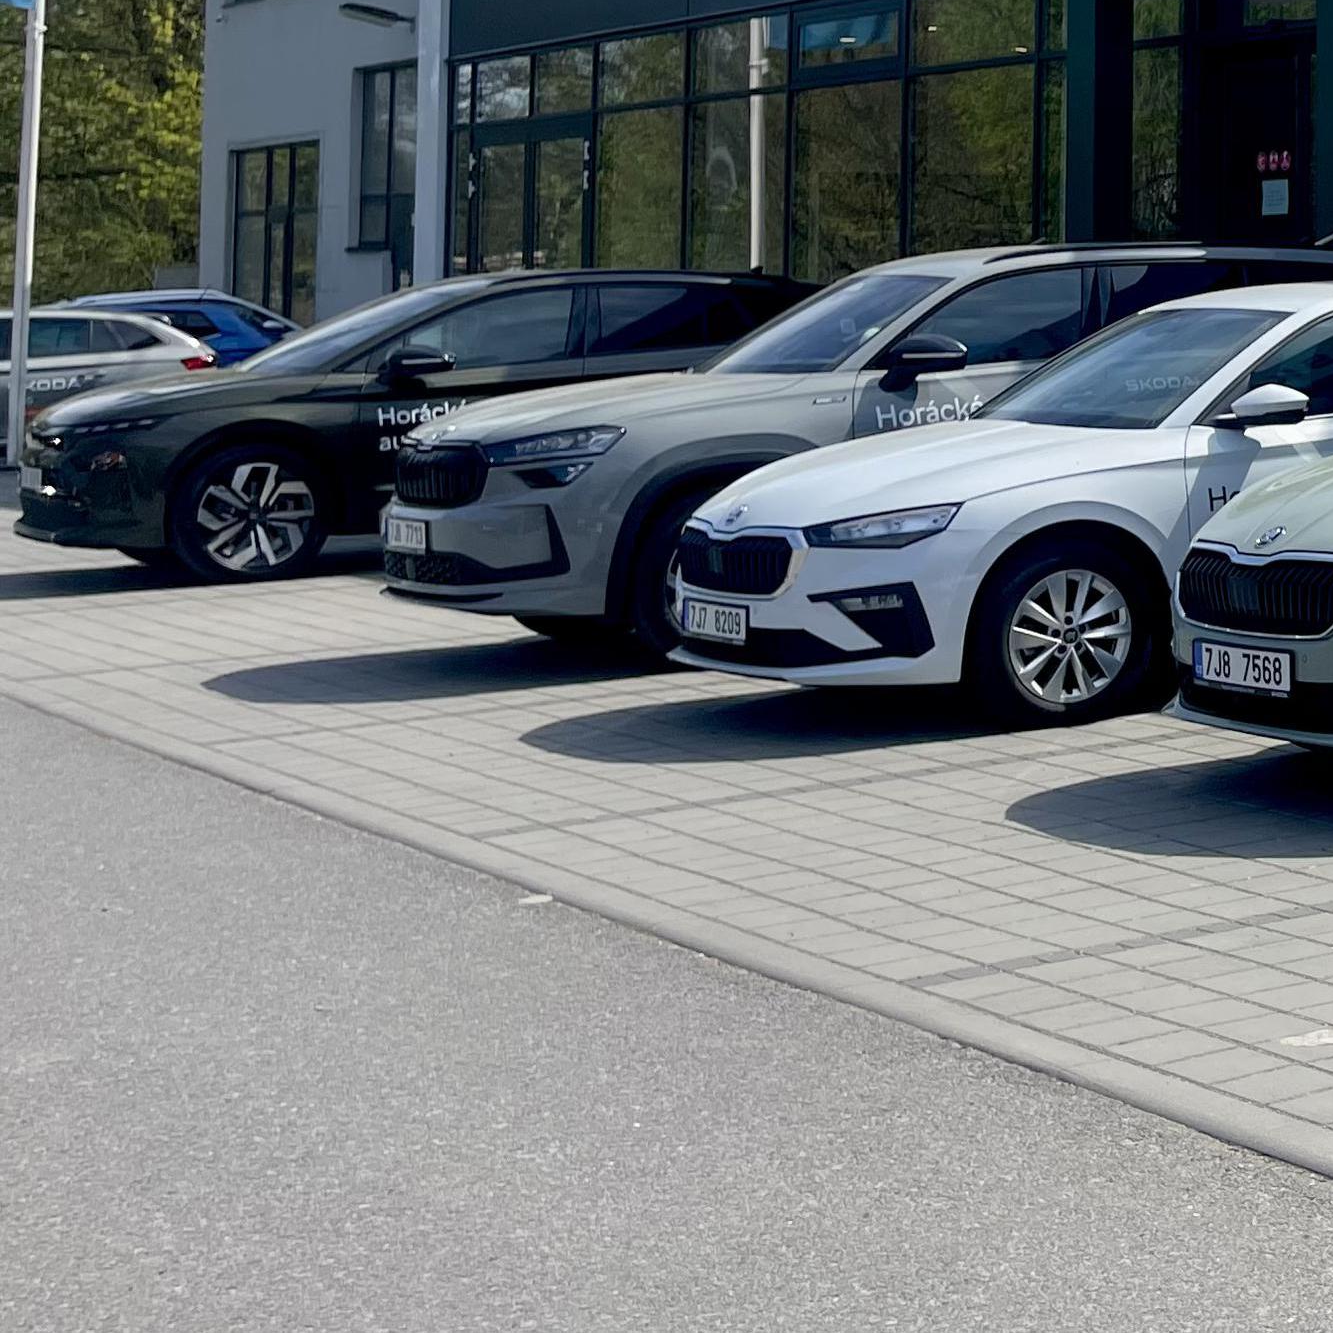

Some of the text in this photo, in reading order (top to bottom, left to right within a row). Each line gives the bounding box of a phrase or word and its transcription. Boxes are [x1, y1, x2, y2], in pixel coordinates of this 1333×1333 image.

[690, 605, 741, 635] 7J7 8209
[1204, 647, 1282, 686] 7J8 7568
